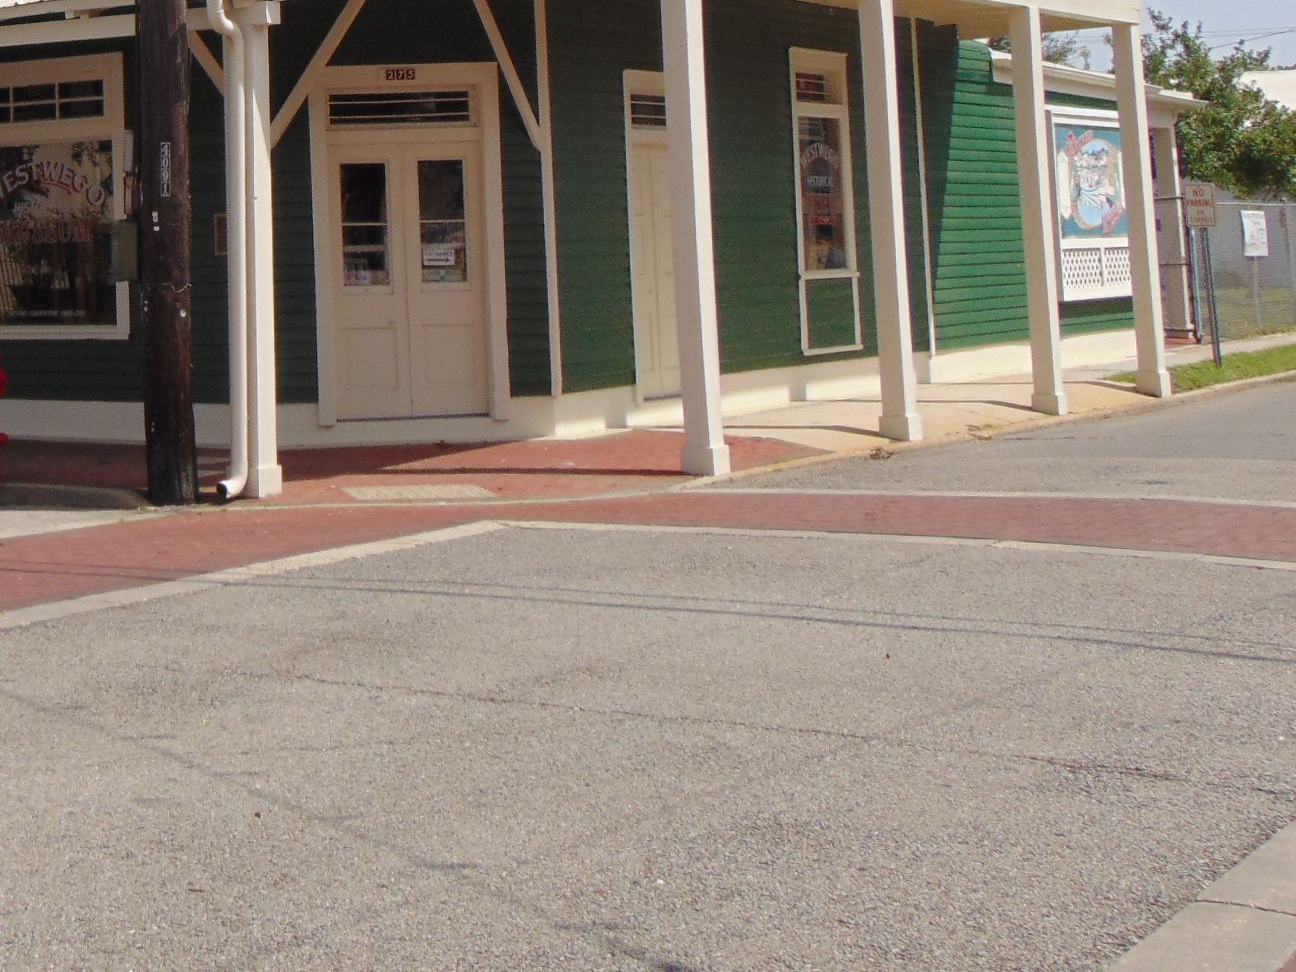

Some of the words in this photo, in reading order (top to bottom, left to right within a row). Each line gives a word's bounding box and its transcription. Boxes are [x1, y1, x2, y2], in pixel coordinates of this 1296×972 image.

[387, 70, 414, 80] 275
[161, 144, 170, 195] 4091
[1192, 188, 1205, 197] NO
[1186, 198, 1213, 207] PARKING
